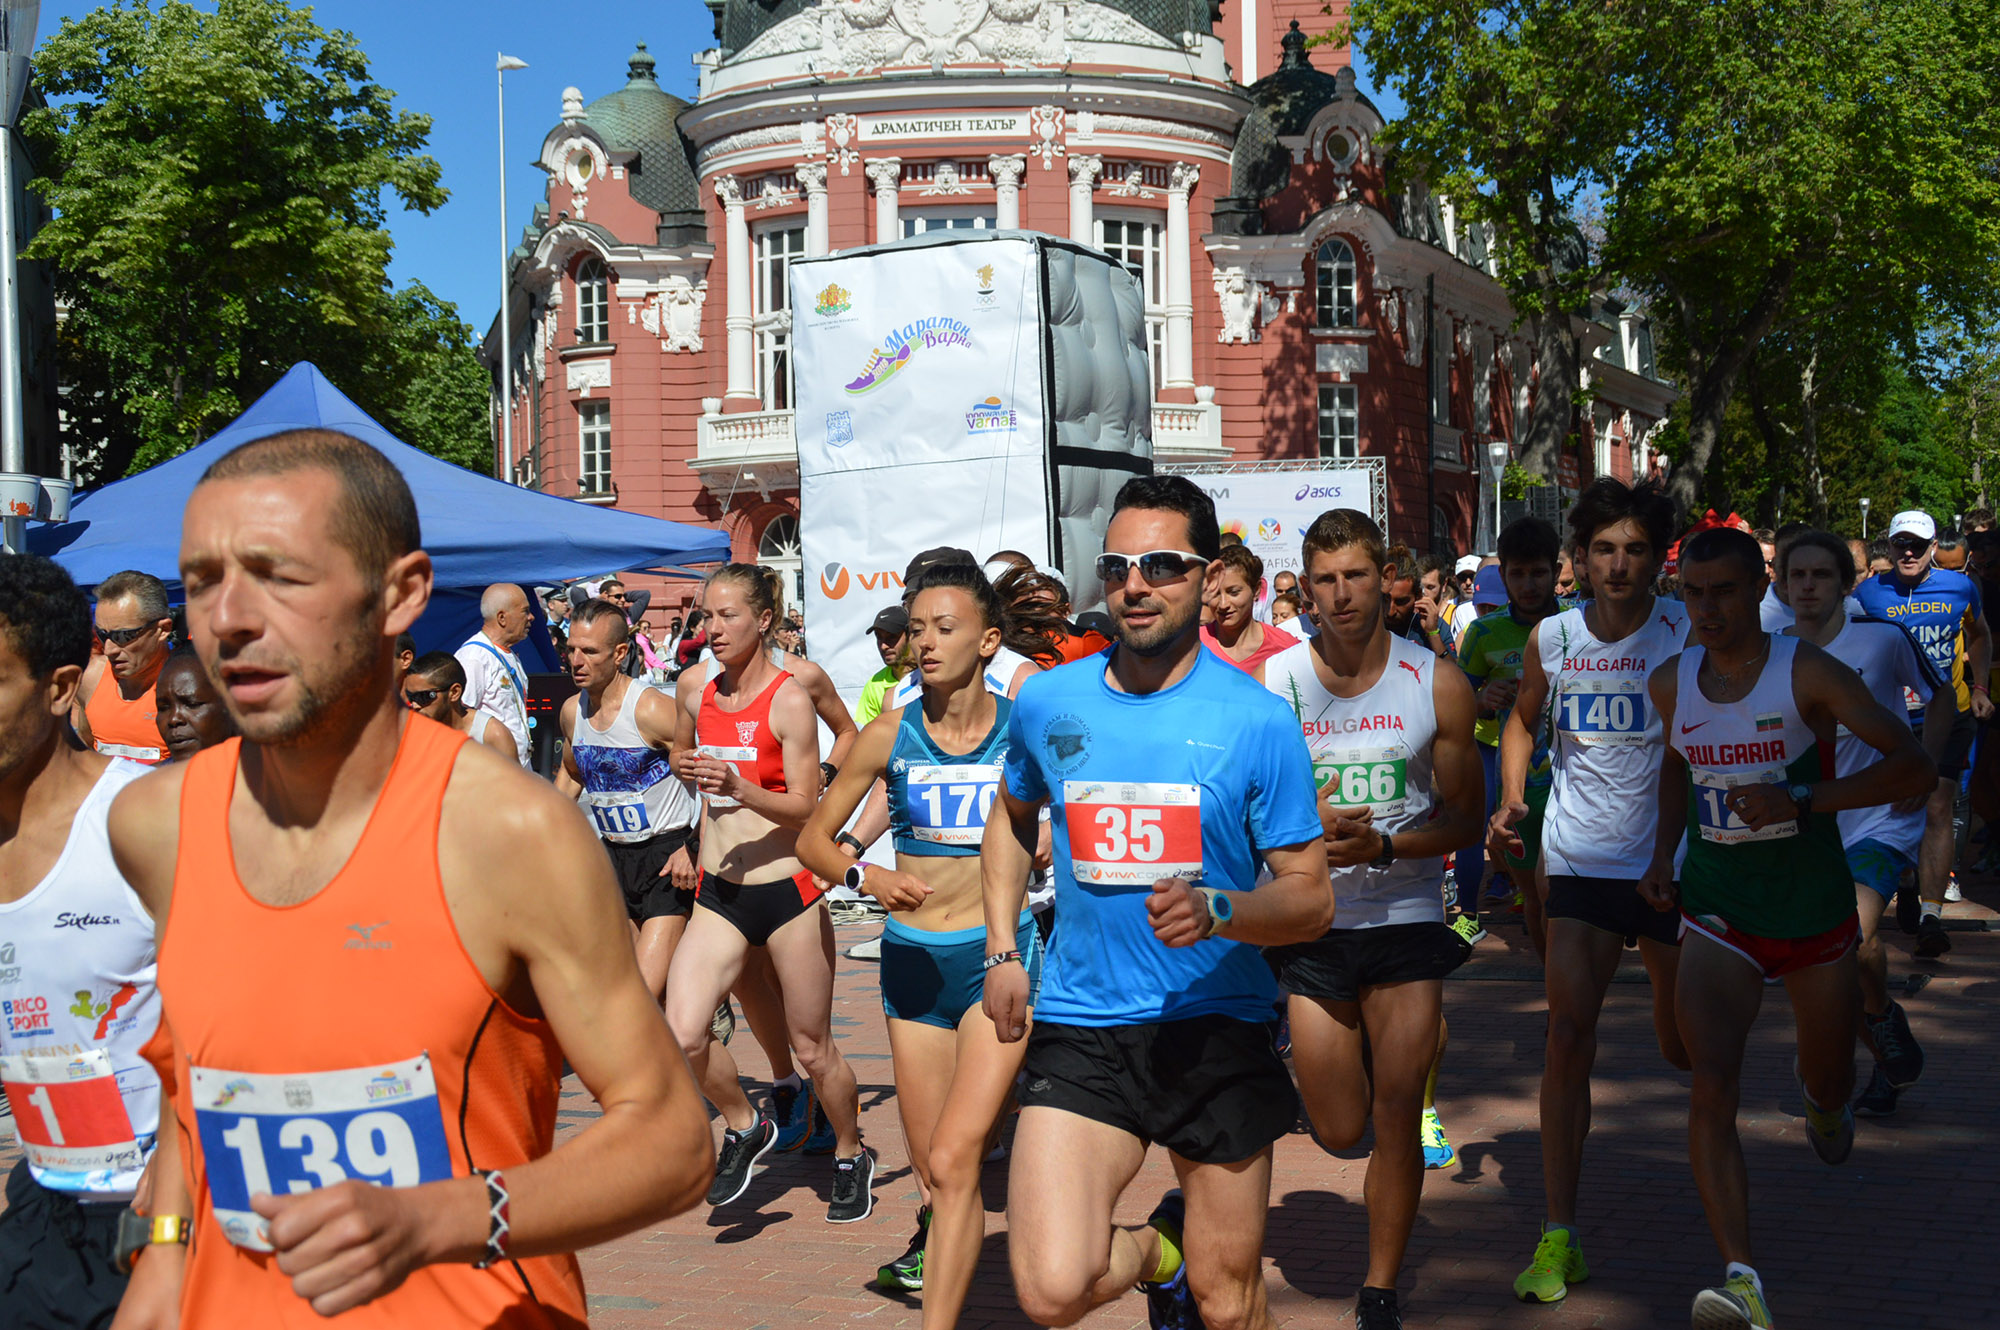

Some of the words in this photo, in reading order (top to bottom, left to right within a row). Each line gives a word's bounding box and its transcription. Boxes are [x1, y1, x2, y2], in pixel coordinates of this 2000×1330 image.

[871, 119, 962, 135] ДРАМАТИЧЕН
[967, 119, 1017, 131] ТЕАТЪР
[884, 316, 971, 355] Маратон
[921, 329, 972, 349] Варна
[966, 415, 1009, 429] varna
[1886, 602, 1952, 618] SWEDEN
[1562, 657, 1646, 671] BULGARIA
[1303, 714, 1404, 737] BULGARIA
[1563, 695, 1634, 731] 140
[1685, 740, 1786, 766] BULGARIA
[1314, 764, 1396, 804] 266
[921, 783, 1000, 827] 170
[596, 805, 643, 833] 119
[1094, 806, 1165, 862] 35
[7, 1013, 50, 1031] SPORT
[28, 1086, 65, 1146] 1
[222, 1111, 420, 1202] 139
